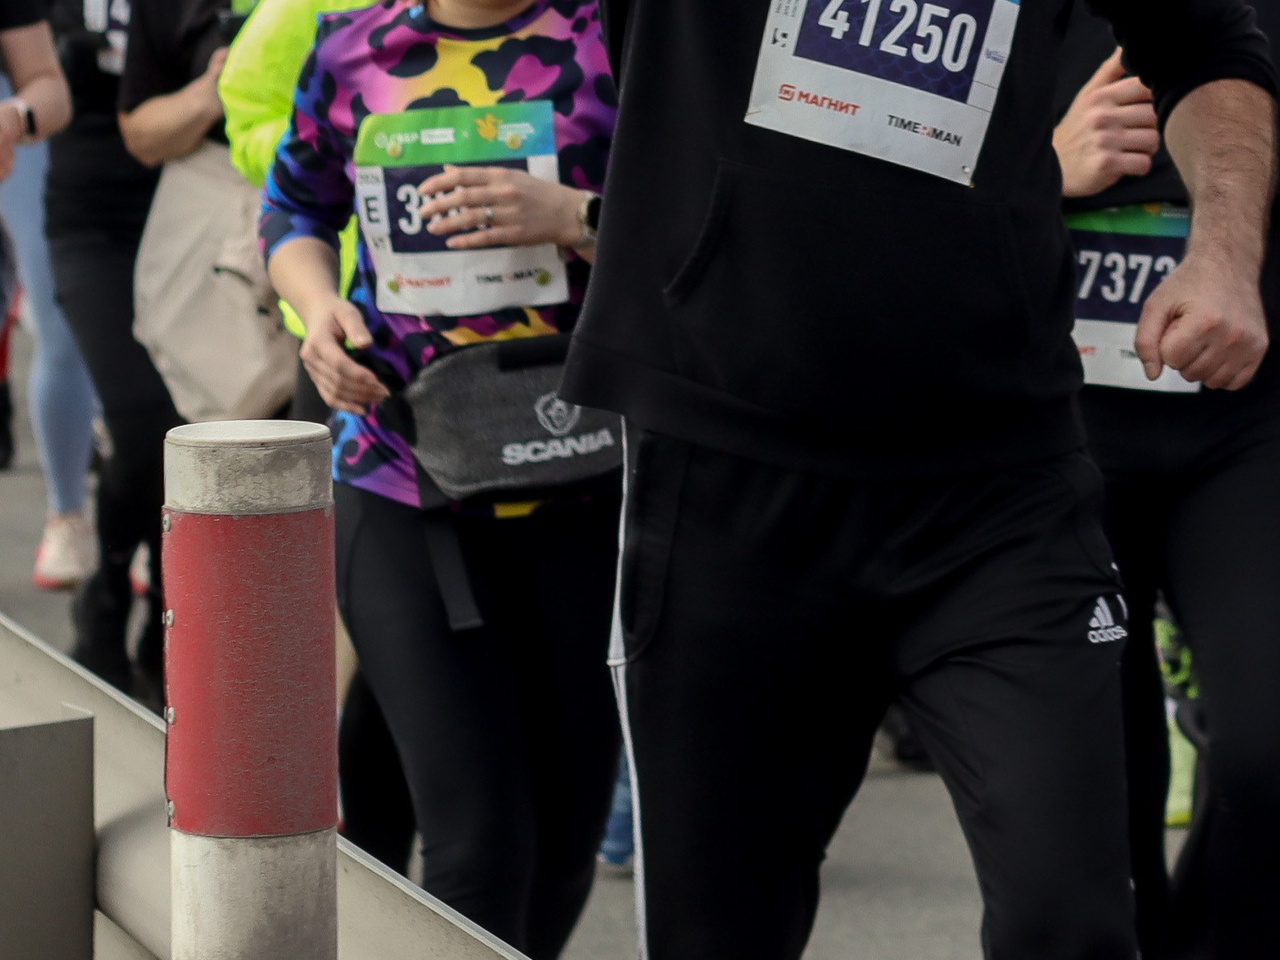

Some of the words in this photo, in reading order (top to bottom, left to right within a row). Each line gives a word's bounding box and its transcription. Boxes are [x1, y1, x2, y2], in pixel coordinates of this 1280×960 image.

[798, 91, 861, 116] МАГНИТ
[364, 196, 381, 224] E
[502, 428, 614, 465] SCANIA
